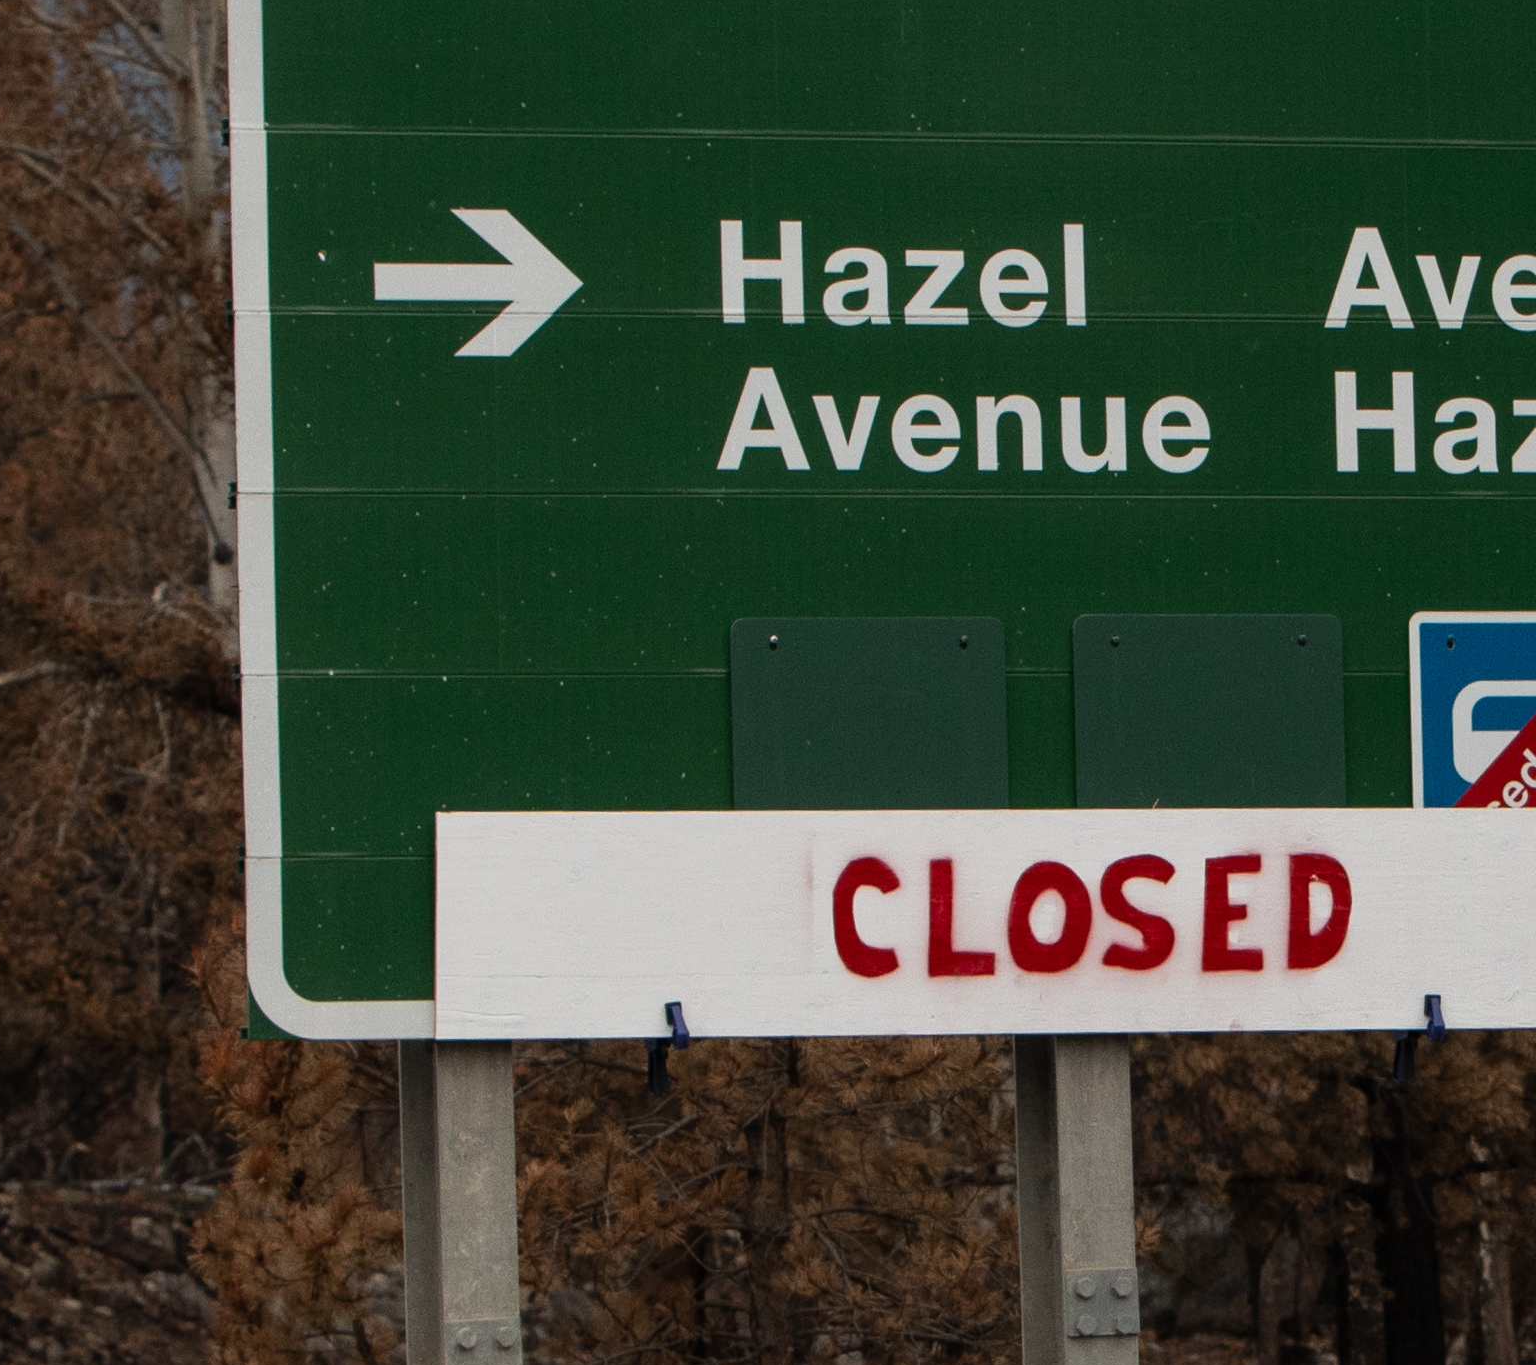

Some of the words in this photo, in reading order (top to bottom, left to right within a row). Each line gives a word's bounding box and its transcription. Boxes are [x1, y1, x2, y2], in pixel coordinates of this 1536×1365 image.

[719, 219, 1086, 327] Hazel
[716, 366, 1212, 473] Avenue
[832, 851, 1354, 981] CLOSED
